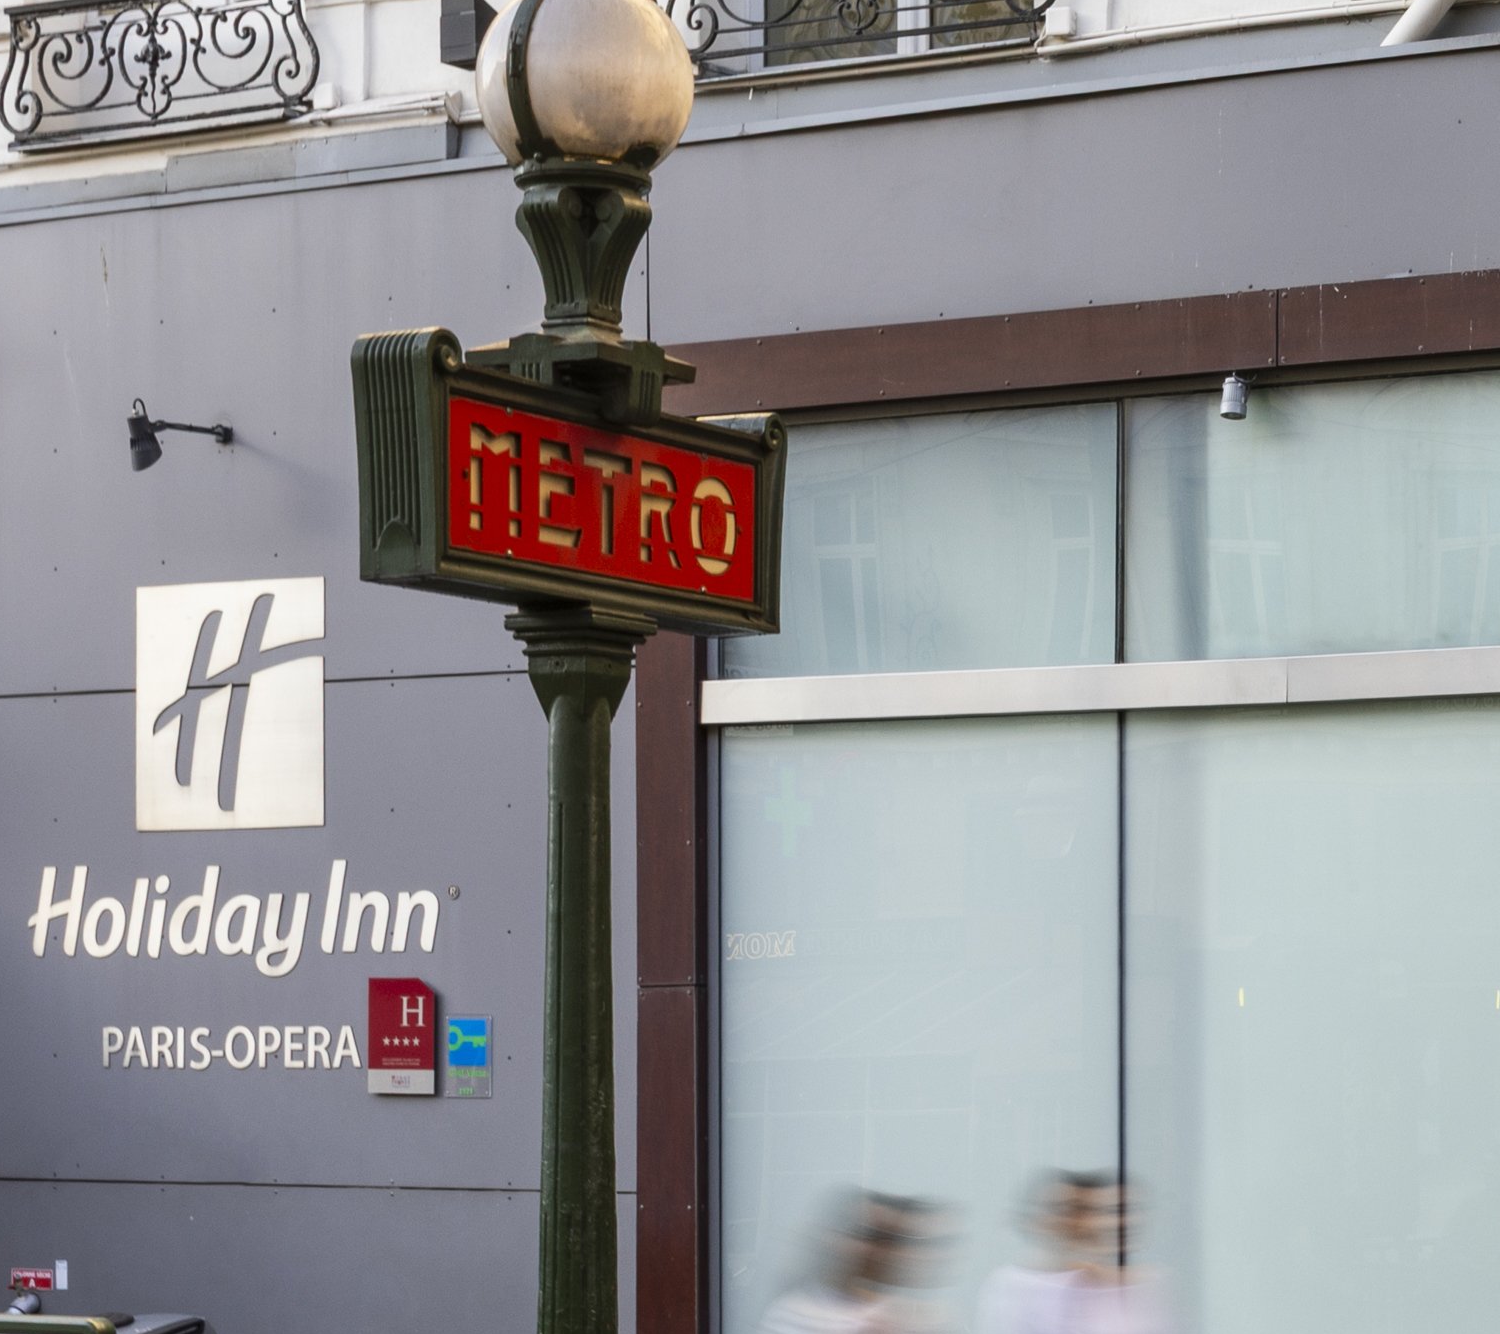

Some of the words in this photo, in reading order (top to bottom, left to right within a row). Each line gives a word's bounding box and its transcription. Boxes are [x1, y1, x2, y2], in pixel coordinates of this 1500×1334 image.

[469, 422, 736, 576] METRO
[27, 865, 311, 977] Holiday
[320, 859, 441, 955] Inn
[102, 1025, 363, 1069] PARIS-OPERA
[400, 995, 426, 1028] H
